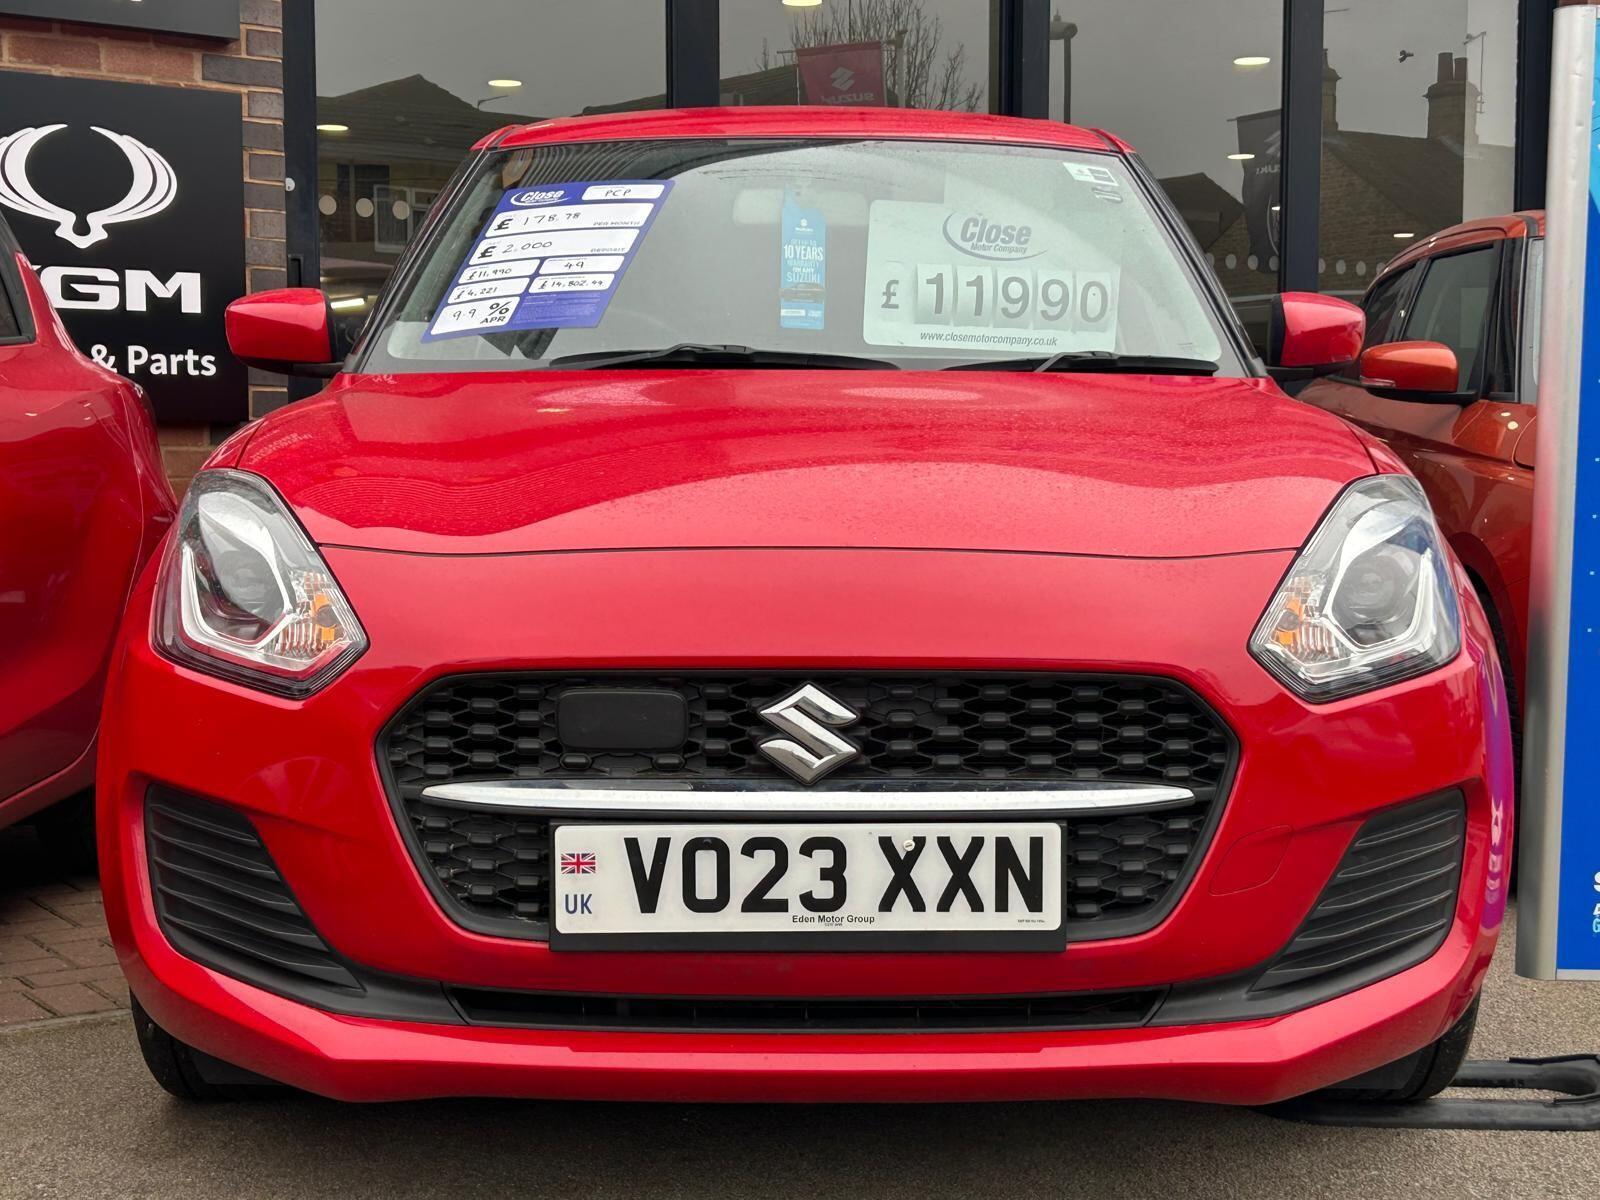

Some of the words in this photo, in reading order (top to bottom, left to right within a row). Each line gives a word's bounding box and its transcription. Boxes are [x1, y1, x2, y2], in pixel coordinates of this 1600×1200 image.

[520, 190, 565, 202] Close
[605, 188, 632, 197] PCP
[493, 218, 513, 231] £
[960, 217, 1032, 246] Close
[477, 246, 497, 259] £
[783, 244, 794, 259] 10
[795, 245, 824, 262] YEARS
[970, 242, 993, 252] Motor
[993, 243, 1028, 255] Company
[786, 272, 820, 283] SUZUKI
[31, 264, 202, 314] GM
[479, 316, 506, 325] APR
[920, 331, 1059, 347] www.closemotorcompany.co.uk
[128, 345, 217, 376] Parts
[623, 836, 848, 914] VO23
[877, 836, 1044, 913] XXN
[564, 893, 593, 915] UK
[792, 914, 815, 923] Eden
[818, 914, 844, 923] Motor
[846, 914, 875, 925] Group
